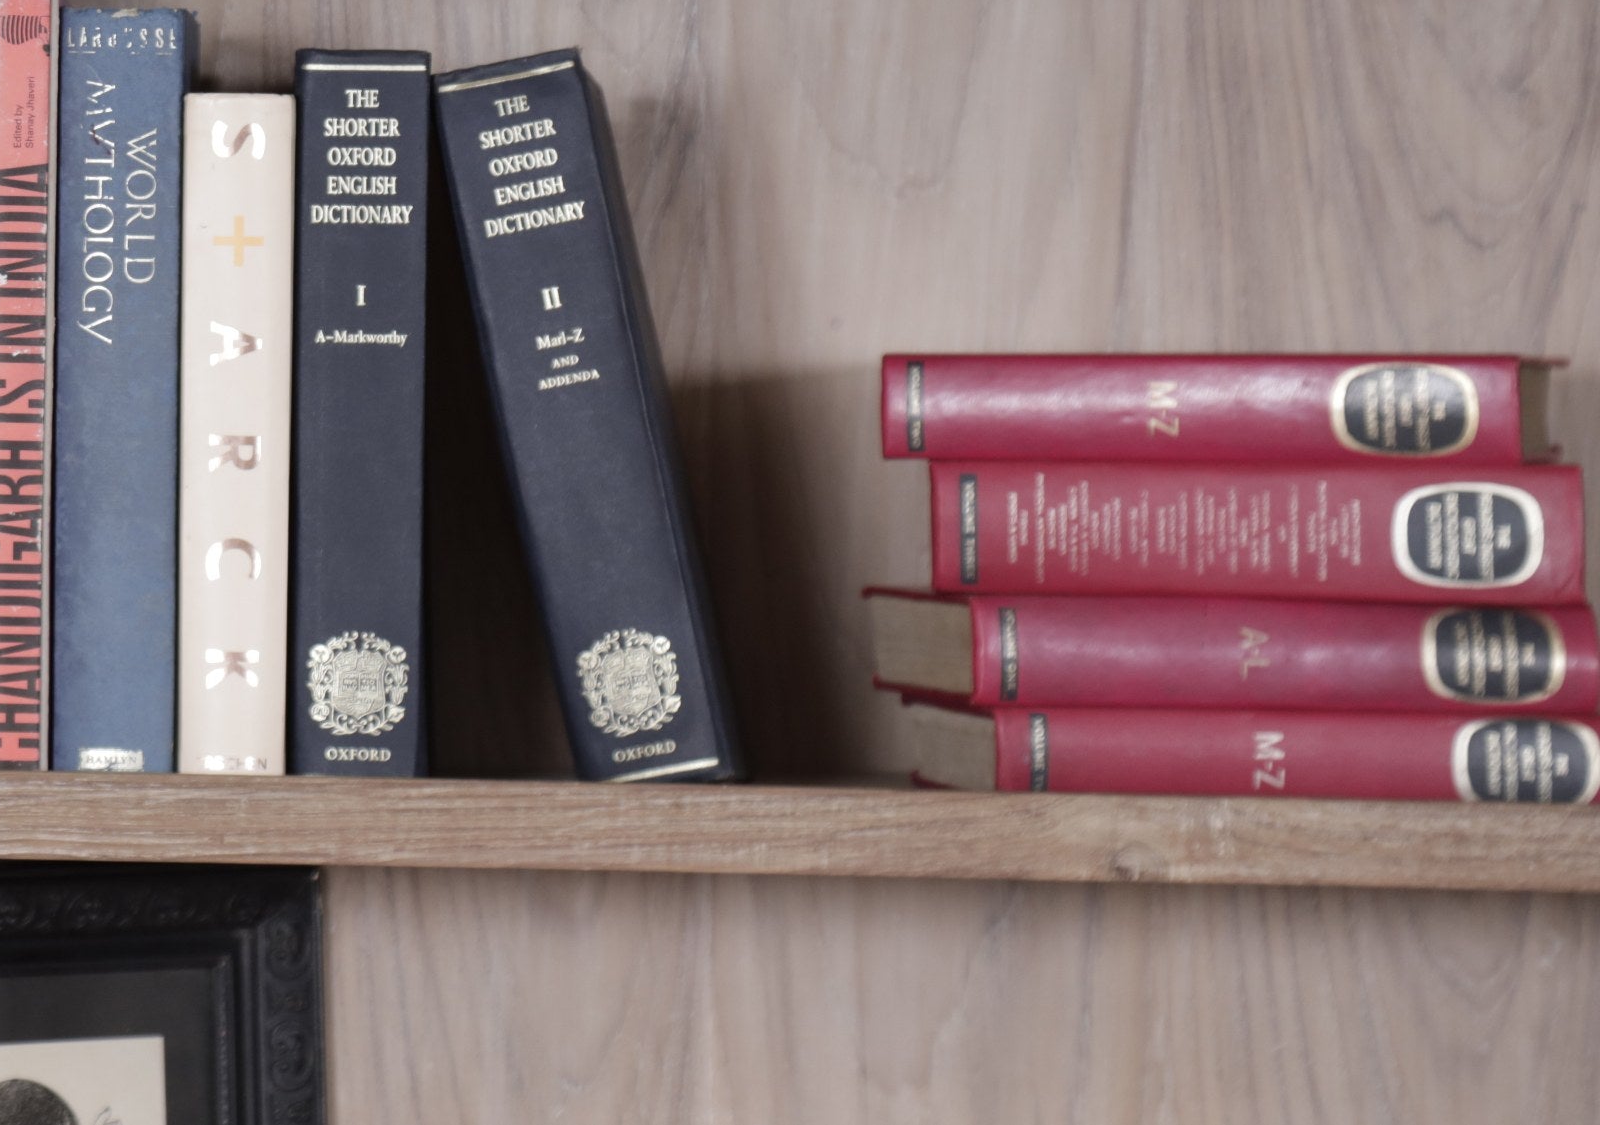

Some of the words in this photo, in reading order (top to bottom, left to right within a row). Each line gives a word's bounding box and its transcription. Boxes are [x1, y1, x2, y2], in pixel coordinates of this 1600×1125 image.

[26, 76, 37, 111] Jhaveri
[345, 88, 380, 109] THE
[494, 94, 531, 118] THE
[13, 104, 25, 116] by
[12, 118, 23, 149] Edited
[25, 113, 37, 149] Shanay
[323, 117, 401, 138] SHORTER
[478, 118, 557, 151] SHORTER
[326, 146, 397, 167] OXFORD
[488, 147, 559, 177] OXFORD
[326, 175, 398, 196] ENGLISH
[494, 175, 566, 207] ENGLISH
[76, 79, 117, 346] MYTHOLOGY
[125, 128, 159, 285] WORLD
[310, 204, 414, 225] DICTIONARY
[483, 201, 586, 239] DICTIONARY
[355, 284, 367, 307] I
[540, 285, 564, 311] II
[550, 353, 581, 371] AND
[537, 368, 601, 391] ADDENDA
[1147, 380, 1180, 438] M-Z
[1239, 625, 1273, 681] A-L
[324, 746, 392, 763] OXFORD
[611, 739, 678, 764] OXFORD
[1251, 729, 1287, 791] M-Z
